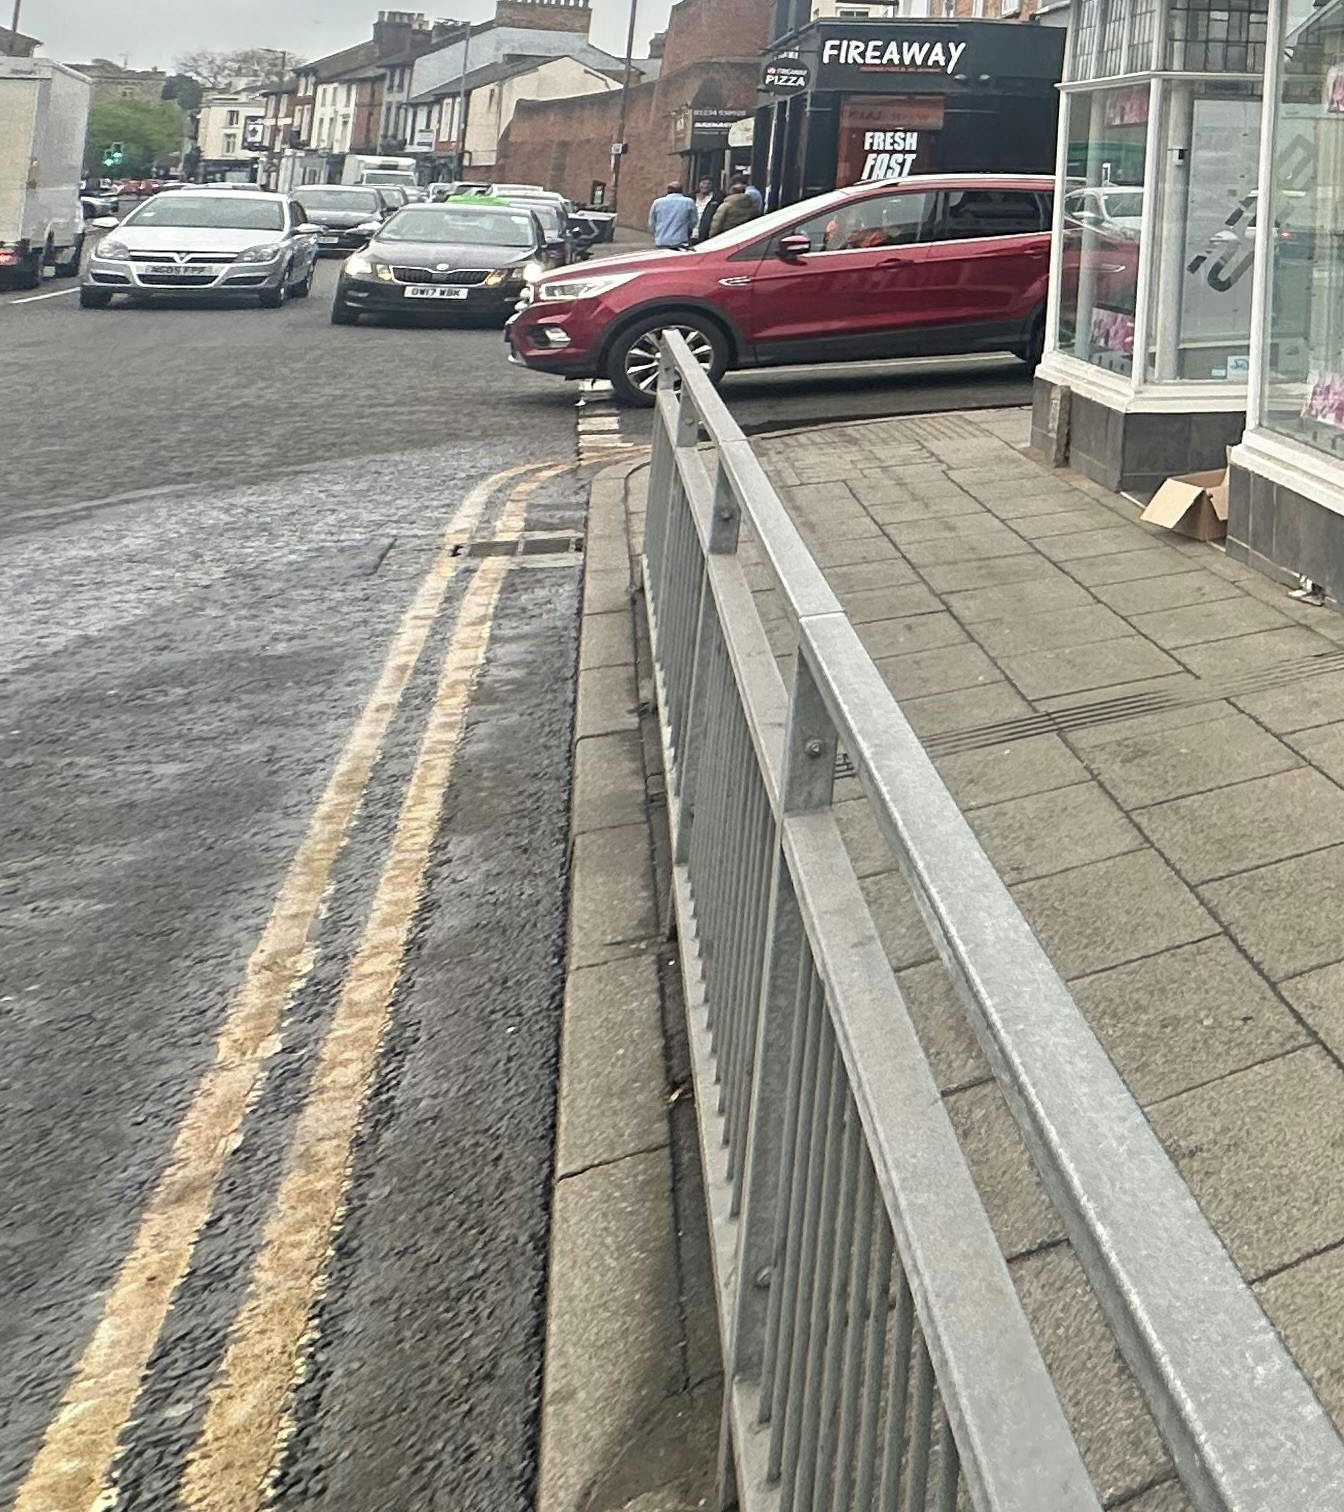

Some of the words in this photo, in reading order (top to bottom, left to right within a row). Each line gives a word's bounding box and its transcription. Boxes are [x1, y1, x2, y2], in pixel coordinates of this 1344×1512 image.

[822, 39, 967, 75] FIREAWAY
[765, 74, 806, 87] PIZZA
[863, 131, 919, 151] FRESH
[861, 153, 917, 180] FAST
